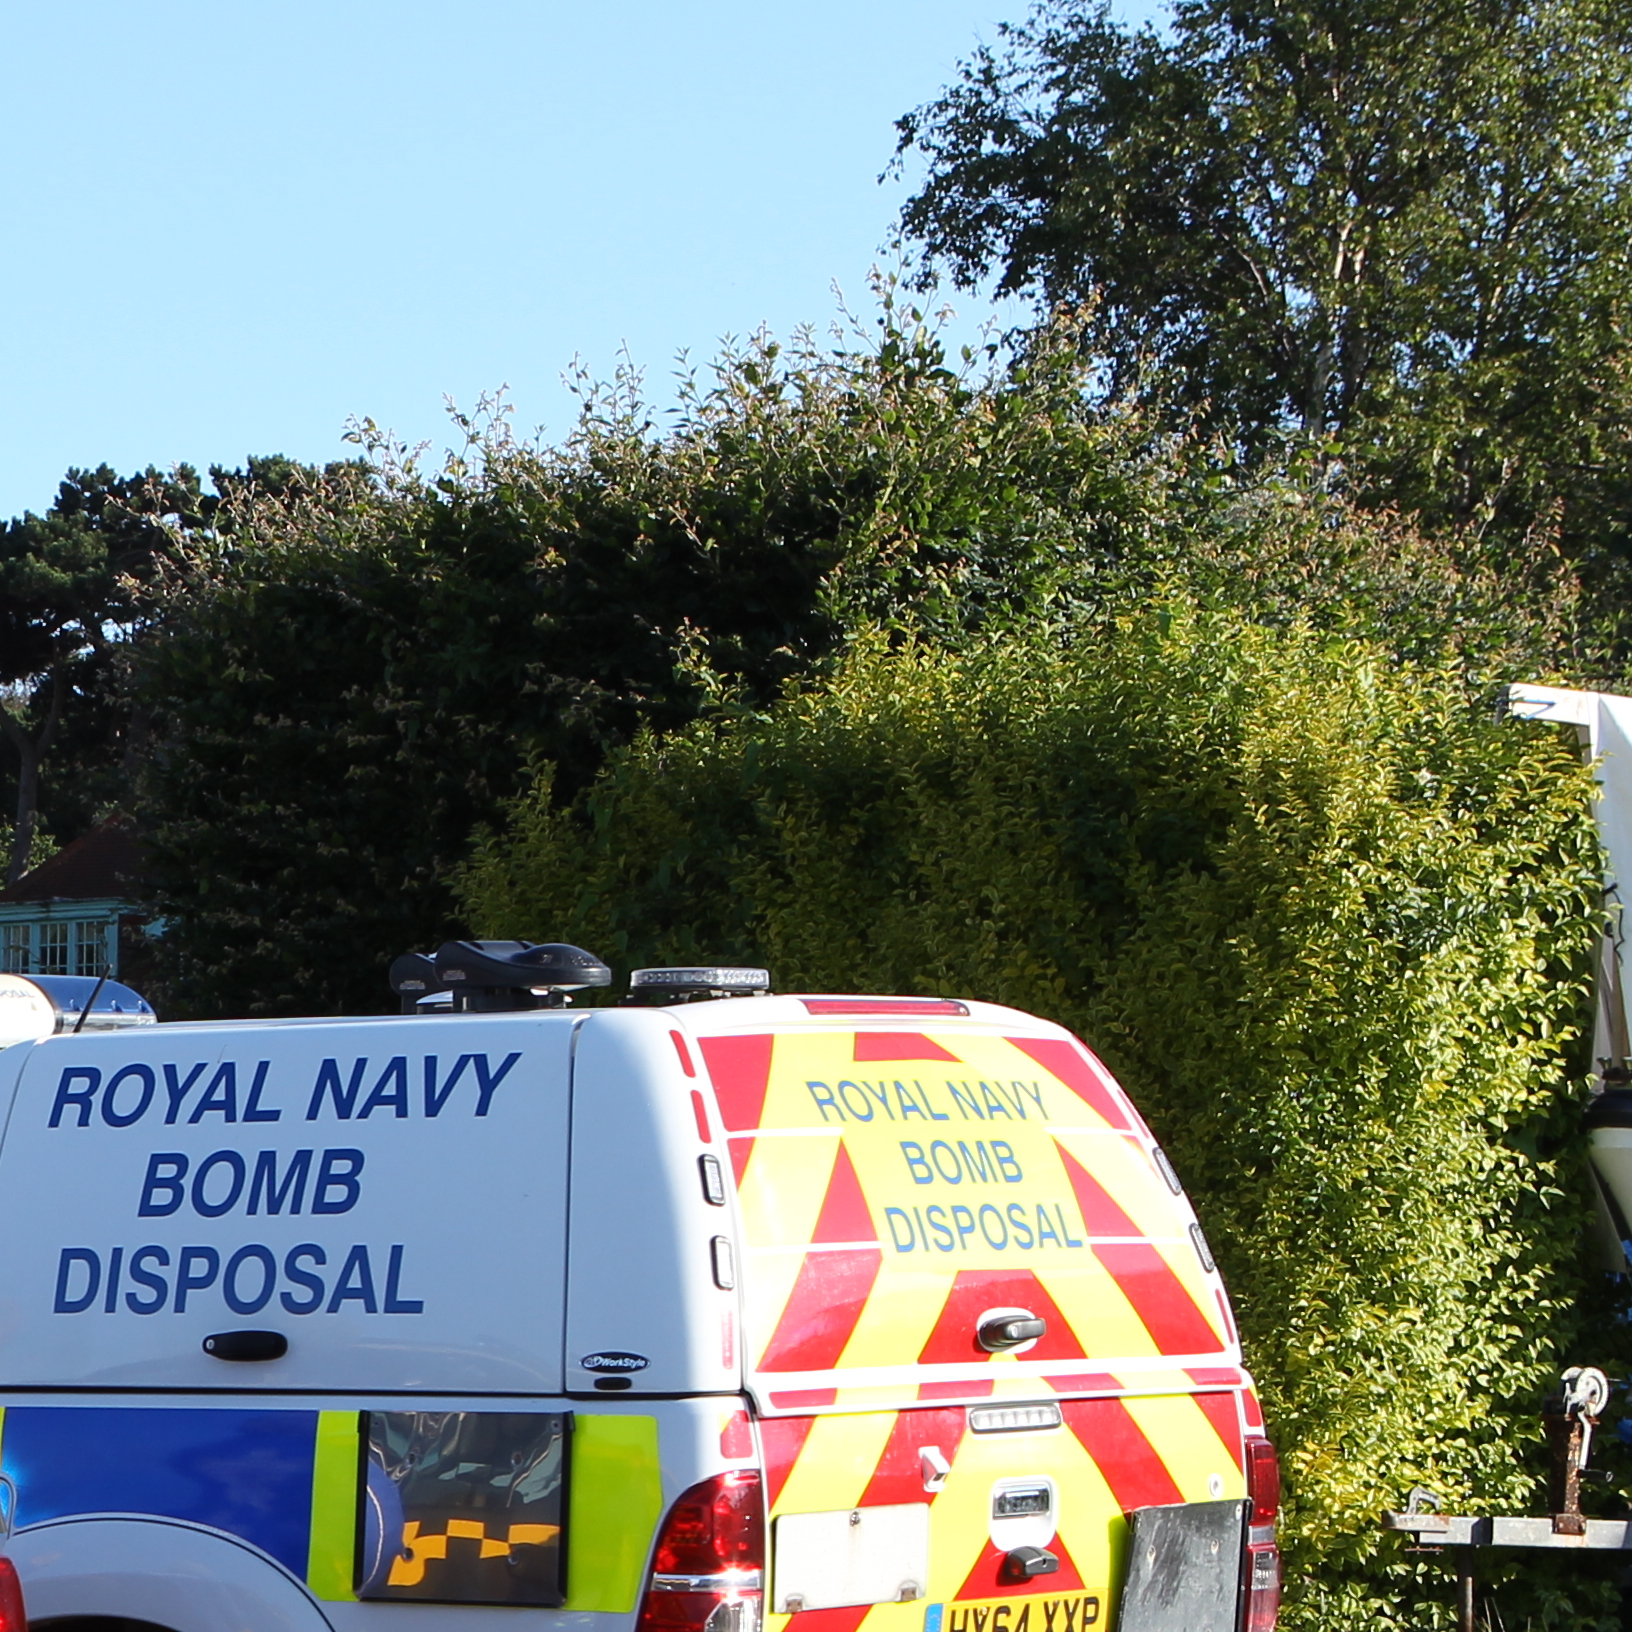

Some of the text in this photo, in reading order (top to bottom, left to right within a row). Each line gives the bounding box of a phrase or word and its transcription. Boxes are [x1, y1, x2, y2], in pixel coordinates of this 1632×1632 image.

[47, 1052, 523, 1129] ROYAL NAVY
[805, 1079, 1051, 1123] ROYAL NAVY
[137, 1148, 365, 1218] BOMB
[899, 1139, 1024, 1185] BOMB
[884, 1202, 1085, 1253] DISPOSAL
[53, 1242, 425, 1316] DISPOSAL
